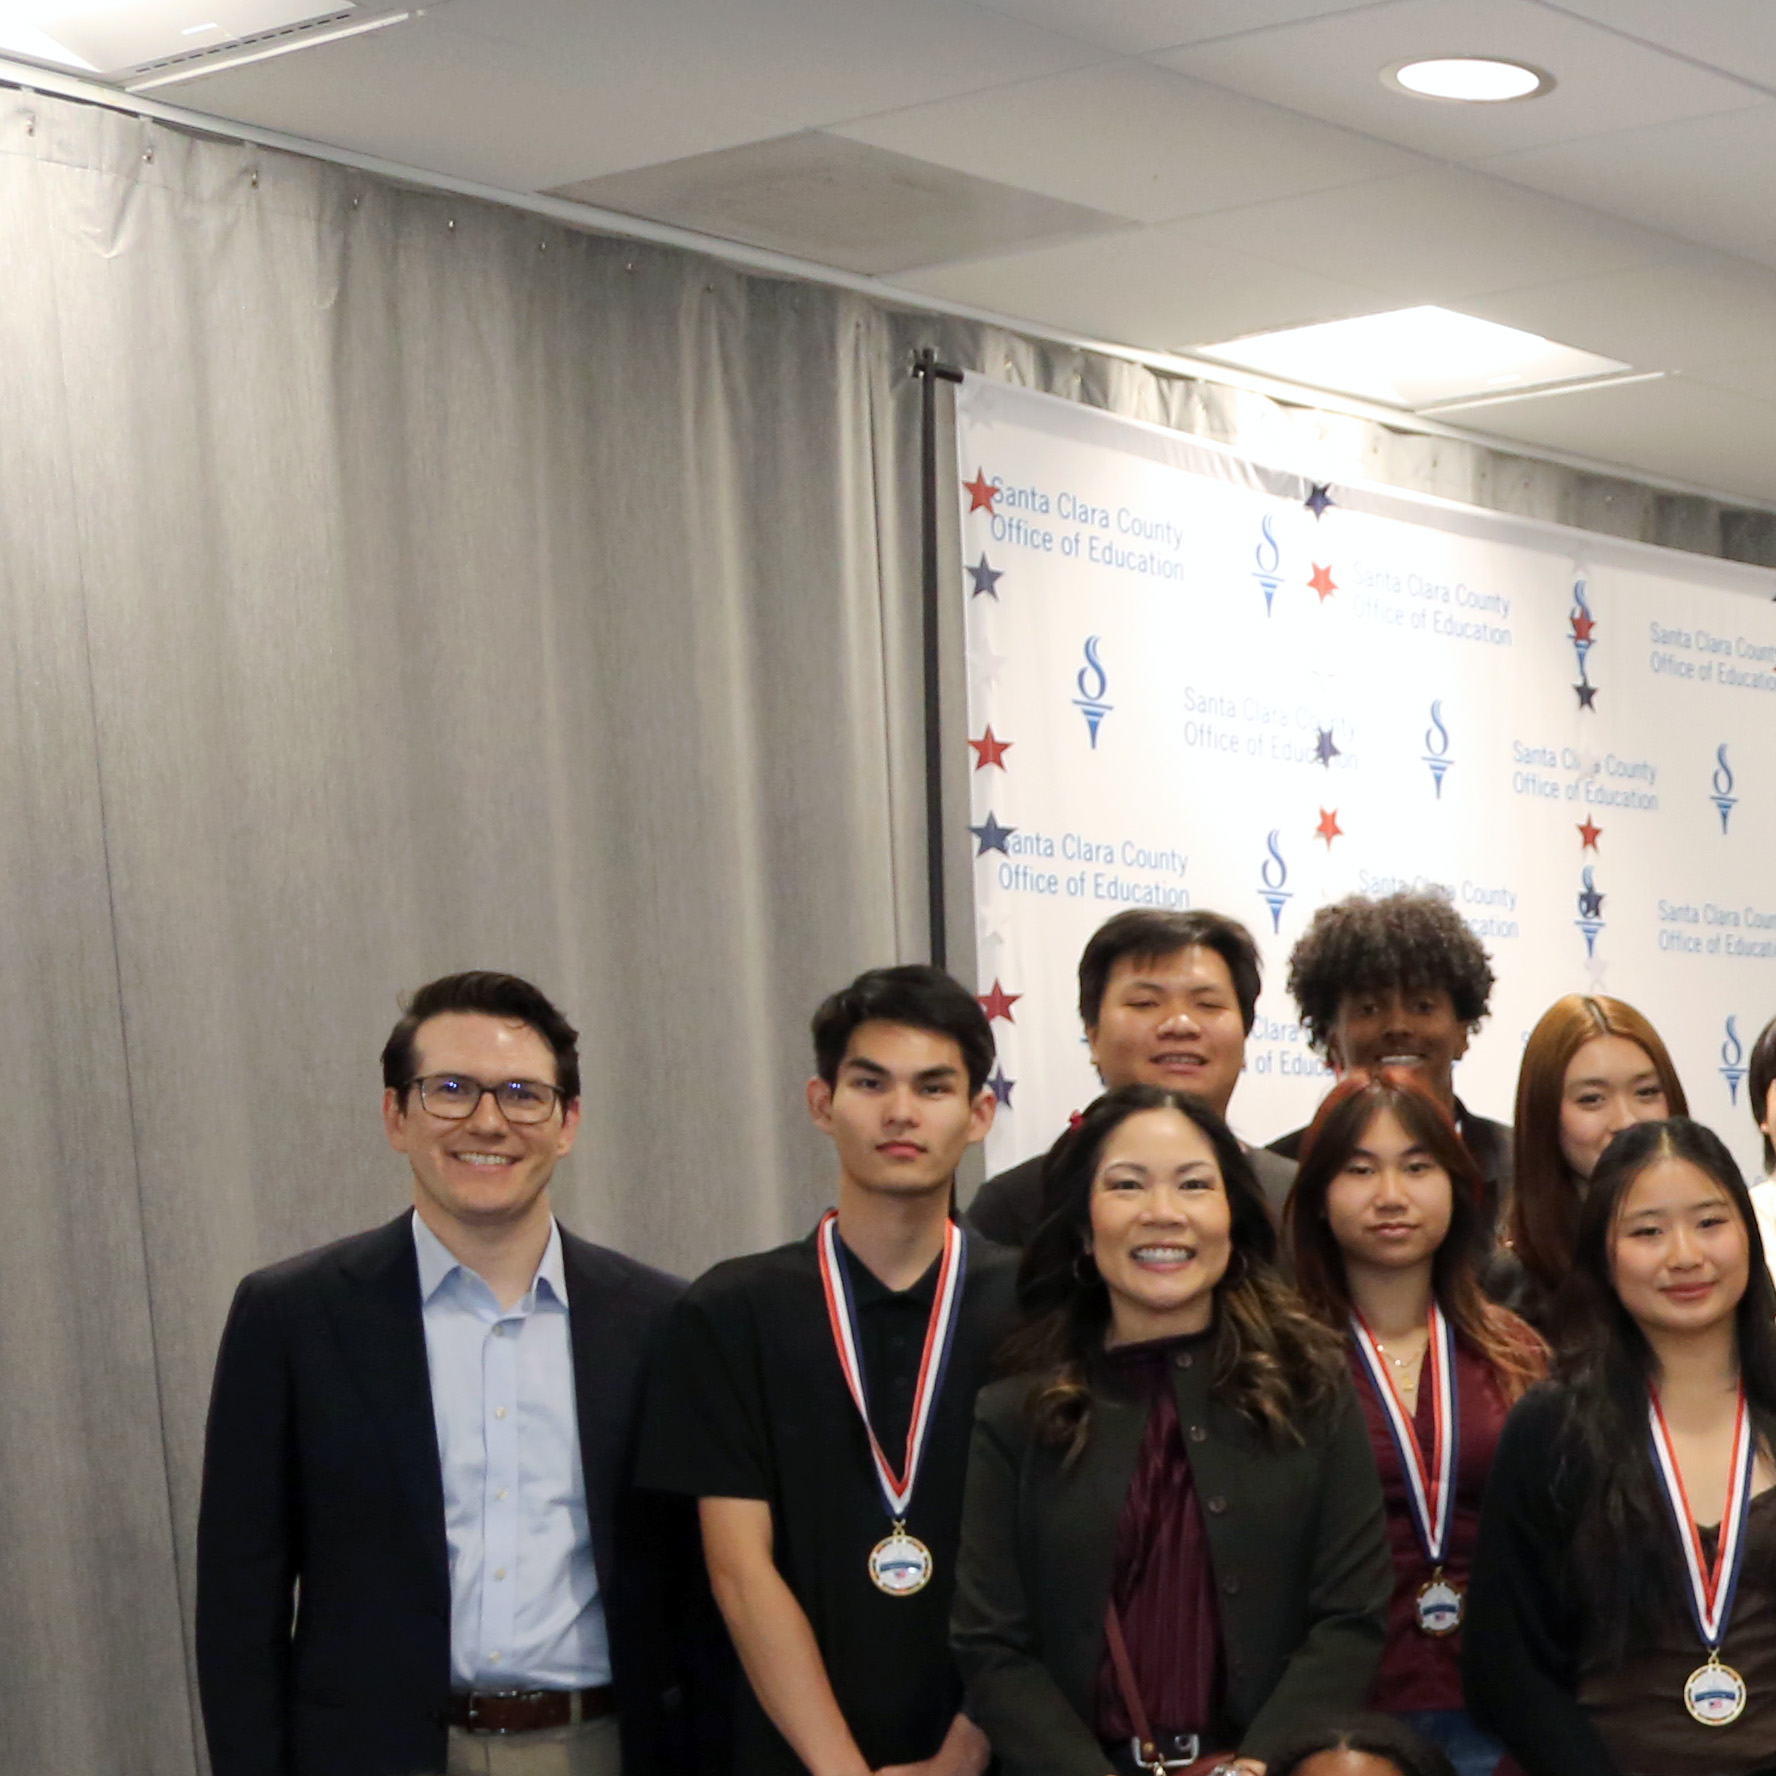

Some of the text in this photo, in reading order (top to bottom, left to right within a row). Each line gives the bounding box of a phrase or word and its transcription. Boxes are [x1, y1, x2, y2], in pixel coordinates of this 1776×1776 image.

[990, 476, 1184, 551] Santa Clara County
[990, 513, 1184, 580] Office of Education
[1352, 560, 1511, 619] Santa Clara County
[1352, 594, 1513, 646] Office of Education
[1649, 620, 1692, 650] Santa
[1694, 630, 1732, 657] Clara
[1649, 650, 1694, 680] Office
[1699, 660, 1713, 681] of
[1184, 686, 1236, 719] Santa
[1242, 697, 1288, 727] Clara
[1184, 720, 1240, 753] Office
[1247, 733, 1263, 756] of
[1513, 740, 1557, 769] Santa
[1604, 753, 1656, 786] County
[1512, 770, 1558, 800] Office
[1585, 780, 1659, 811] Education
[1010, 833, 1188, 878] anta Clara County
[999, 862, 1190, 908] Office of Education
[1462, 880, 1518, 913] County
[1658, 899, 1700, 923] Santa
[1703, 902, 1740, 927] Clara
[1658, 928, 1701, 953] Office
[1705, 932, 1721, 954] of
[1255, 1049, 1272, 1074] of
